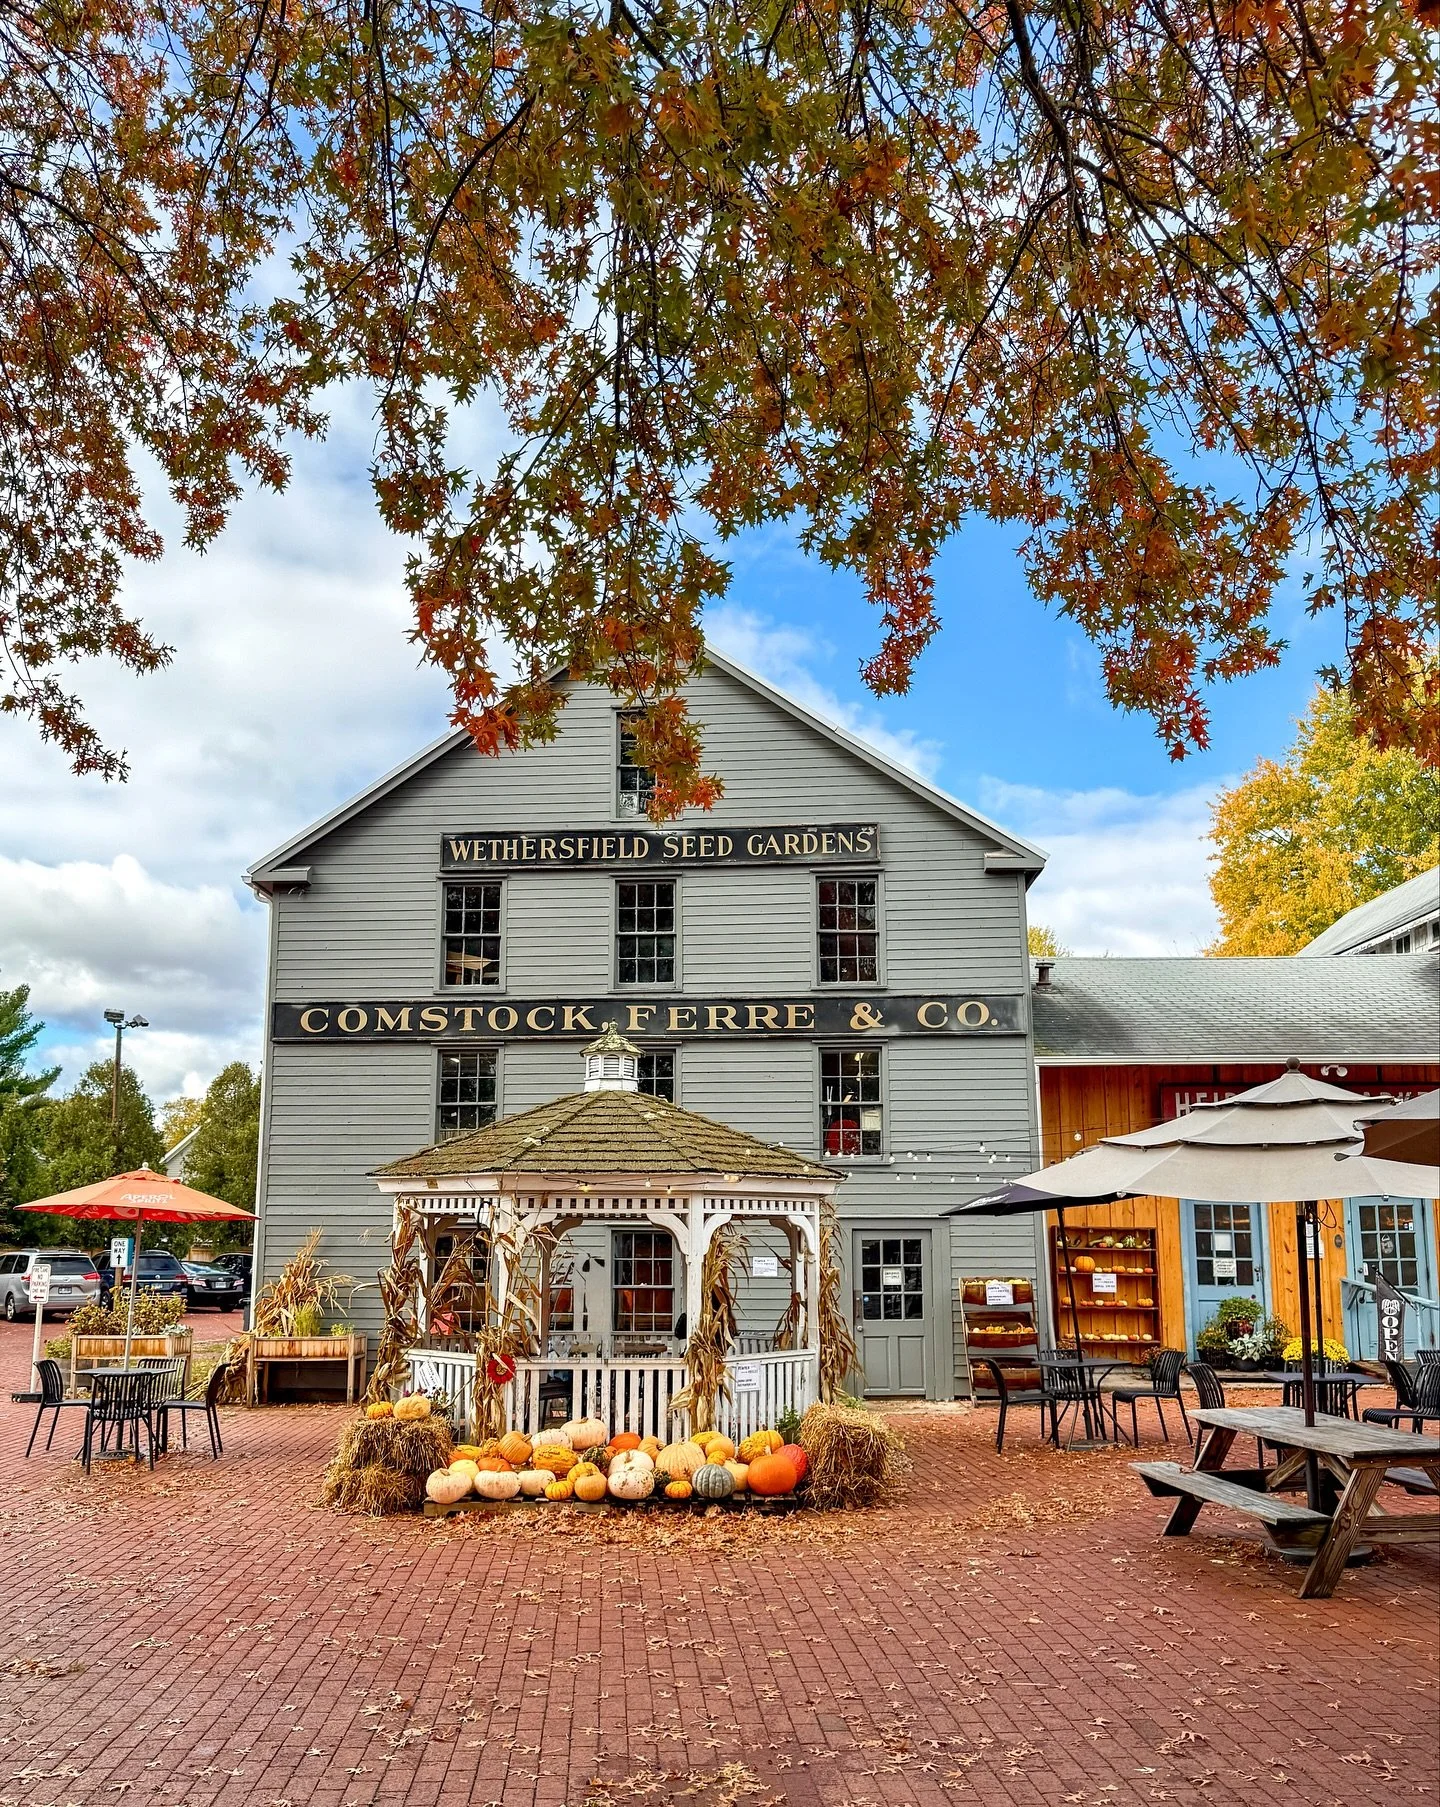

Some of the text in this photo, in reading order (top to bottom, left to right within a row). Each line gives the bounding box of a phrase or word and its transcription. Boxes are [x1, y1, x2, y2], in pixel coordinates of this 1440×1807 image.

[449, 830, 872, 862] WETHERSFIELD SEED GARDENS
[626, 1004, 815, 1031] FERRE
[849, 1002, 885, 1030] &
[916, 1001, 998, 1029] CO.
[1381, 1315, 1399, 1361] OPEN
